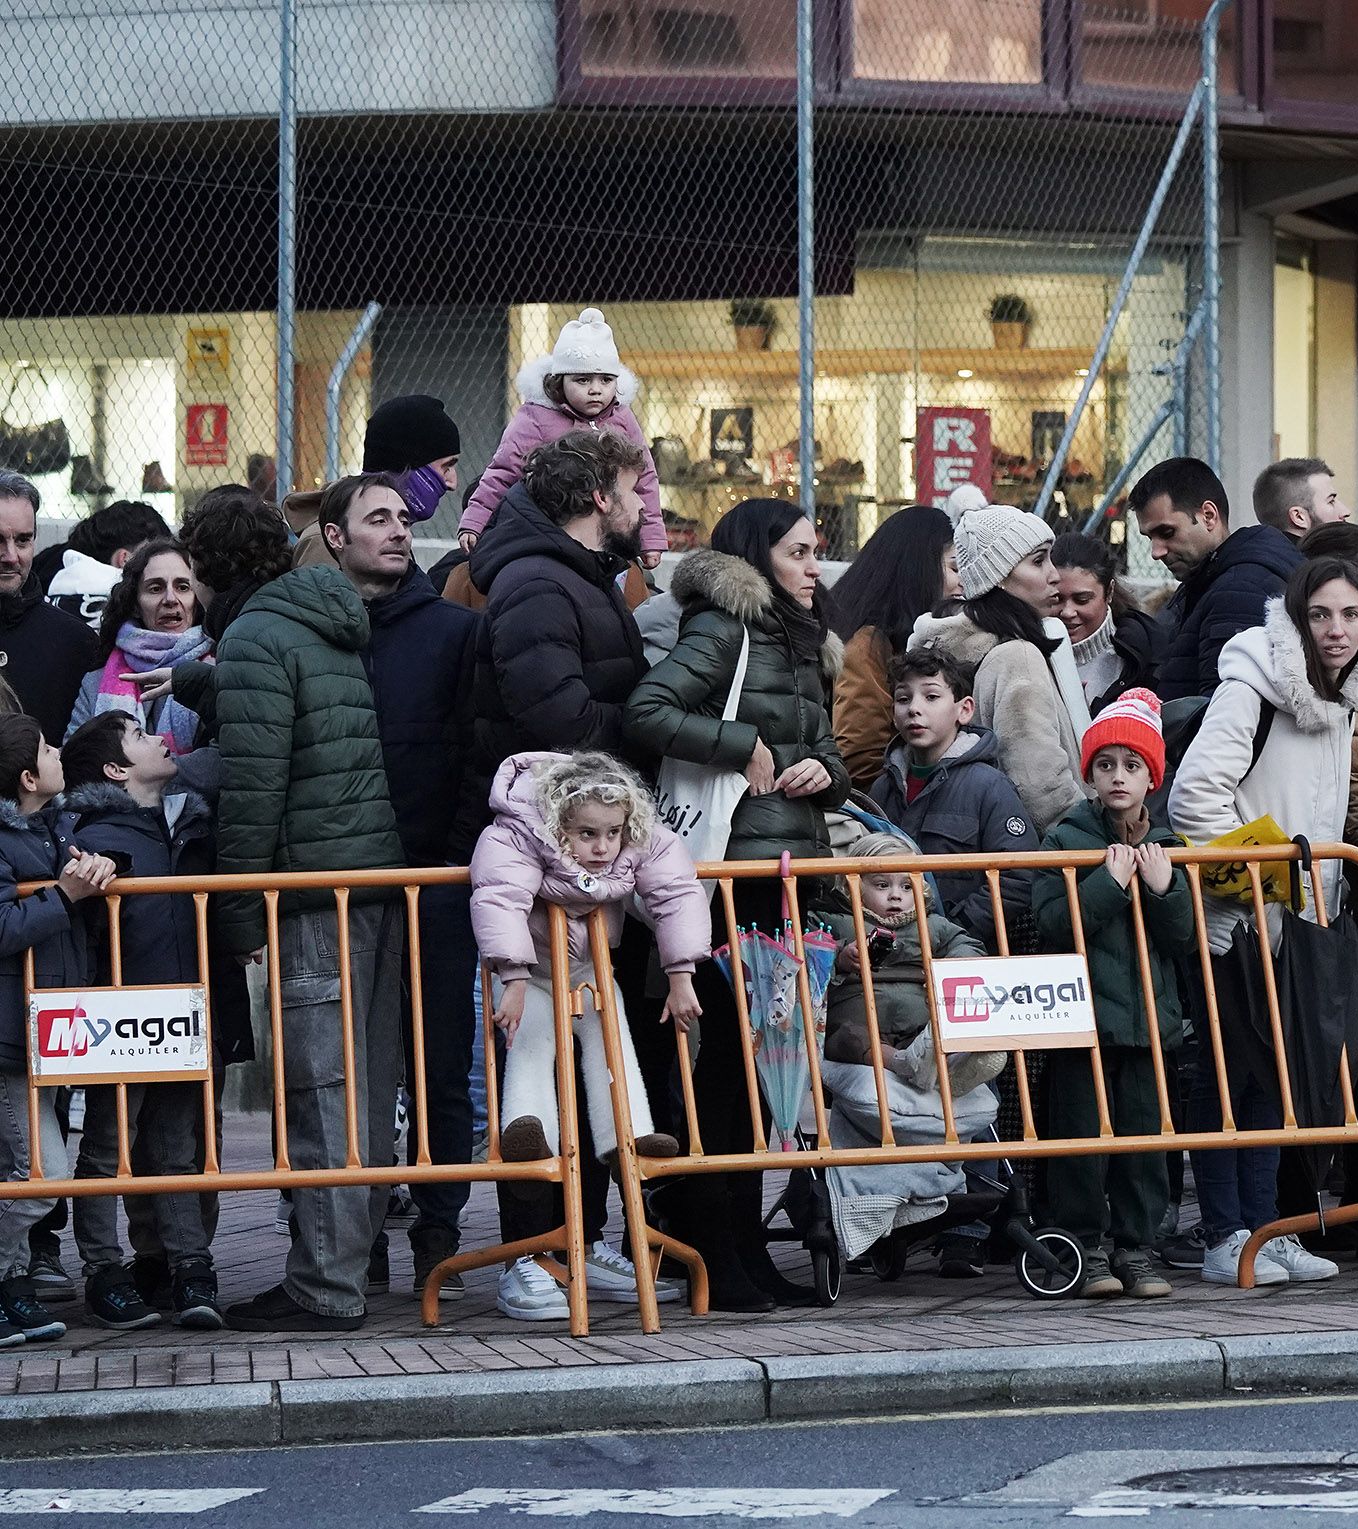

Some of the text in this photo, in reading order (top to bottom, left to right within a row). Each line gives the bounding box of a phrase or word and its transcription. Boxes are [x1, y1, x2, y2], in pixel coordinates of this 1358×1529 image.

[932, 416, 979, 509] RE
[953, 977, 1086, 1017] Myagal
[1010, 1011, 1070, 1022] ALQUILER
[47, 1010, 200, 1051] Myagal
[110, 1046, 179, 1057] ALQUILER
